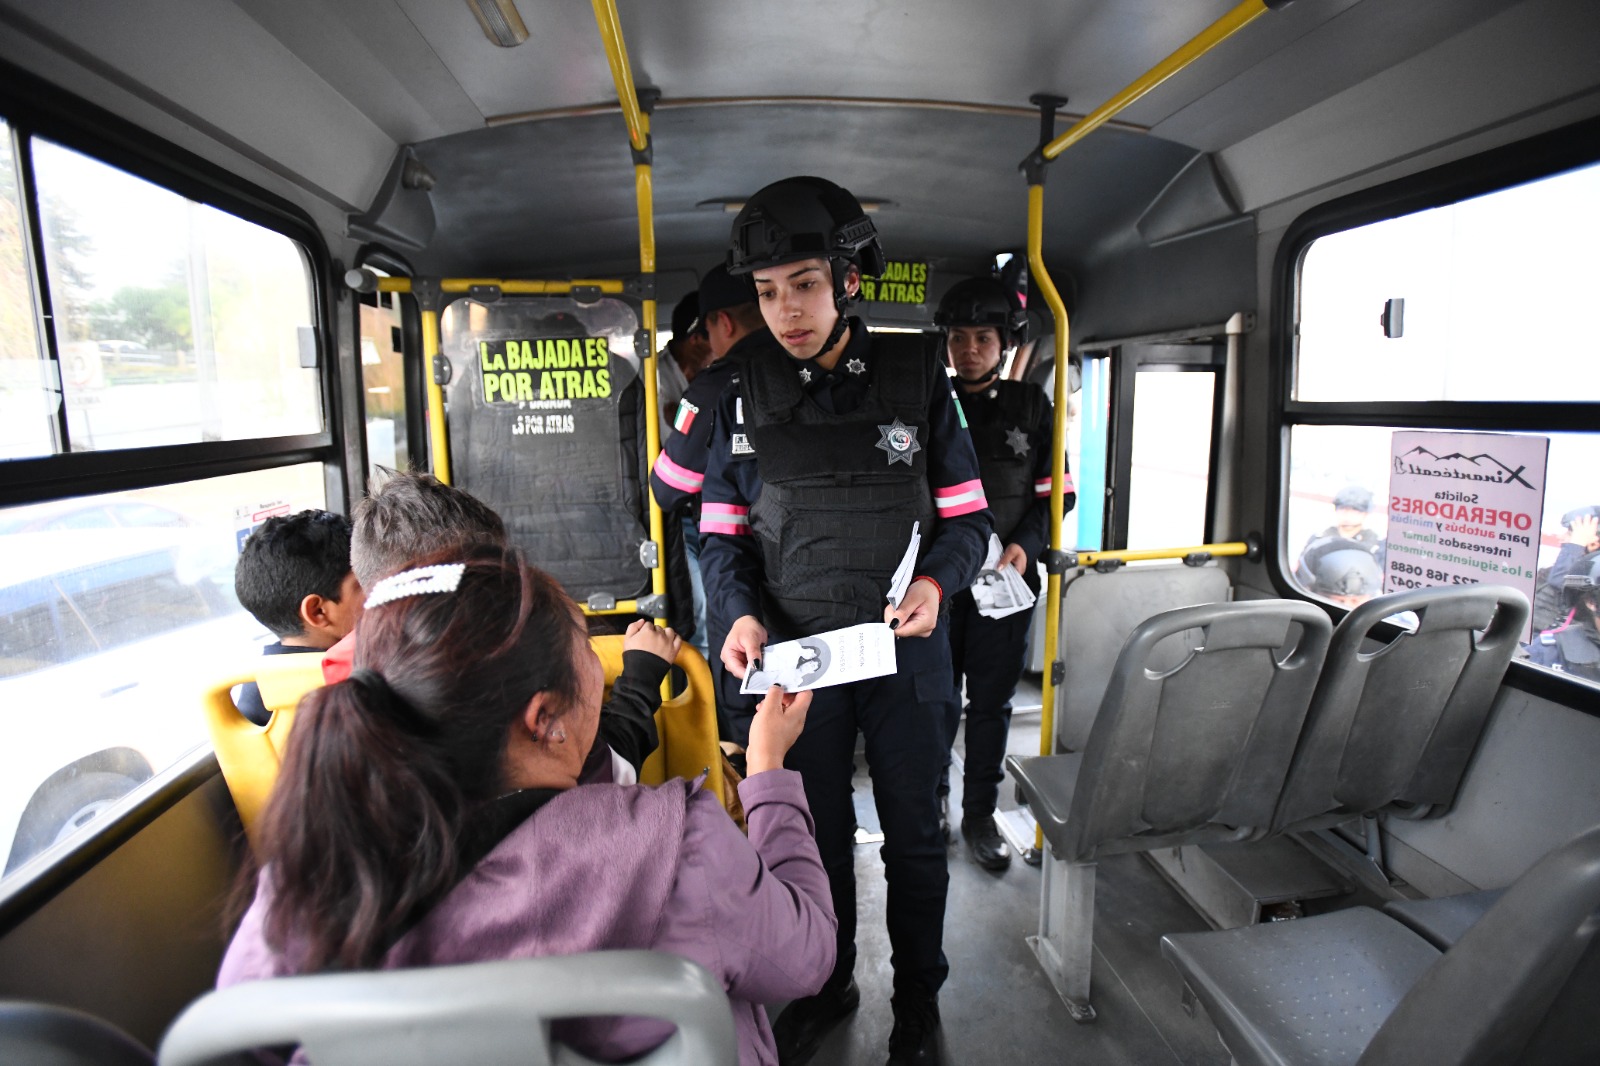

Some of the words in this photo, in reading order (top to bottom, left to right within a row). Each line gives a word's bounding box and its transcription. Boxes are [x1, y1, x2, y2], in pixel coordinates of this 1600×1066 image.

[912, 263, 927, 282] ES
[879, 282, 925, 304] ATRAS
[506, 338, 585, 370] BAJADA
[585, 337, 609, 368] ES
[484, 372, 534, 403] POR
[540, 368, 612, 400] ATRAS
[525, 415, 544, 434] POR
[546, 414, 574, 433] ATRAS
